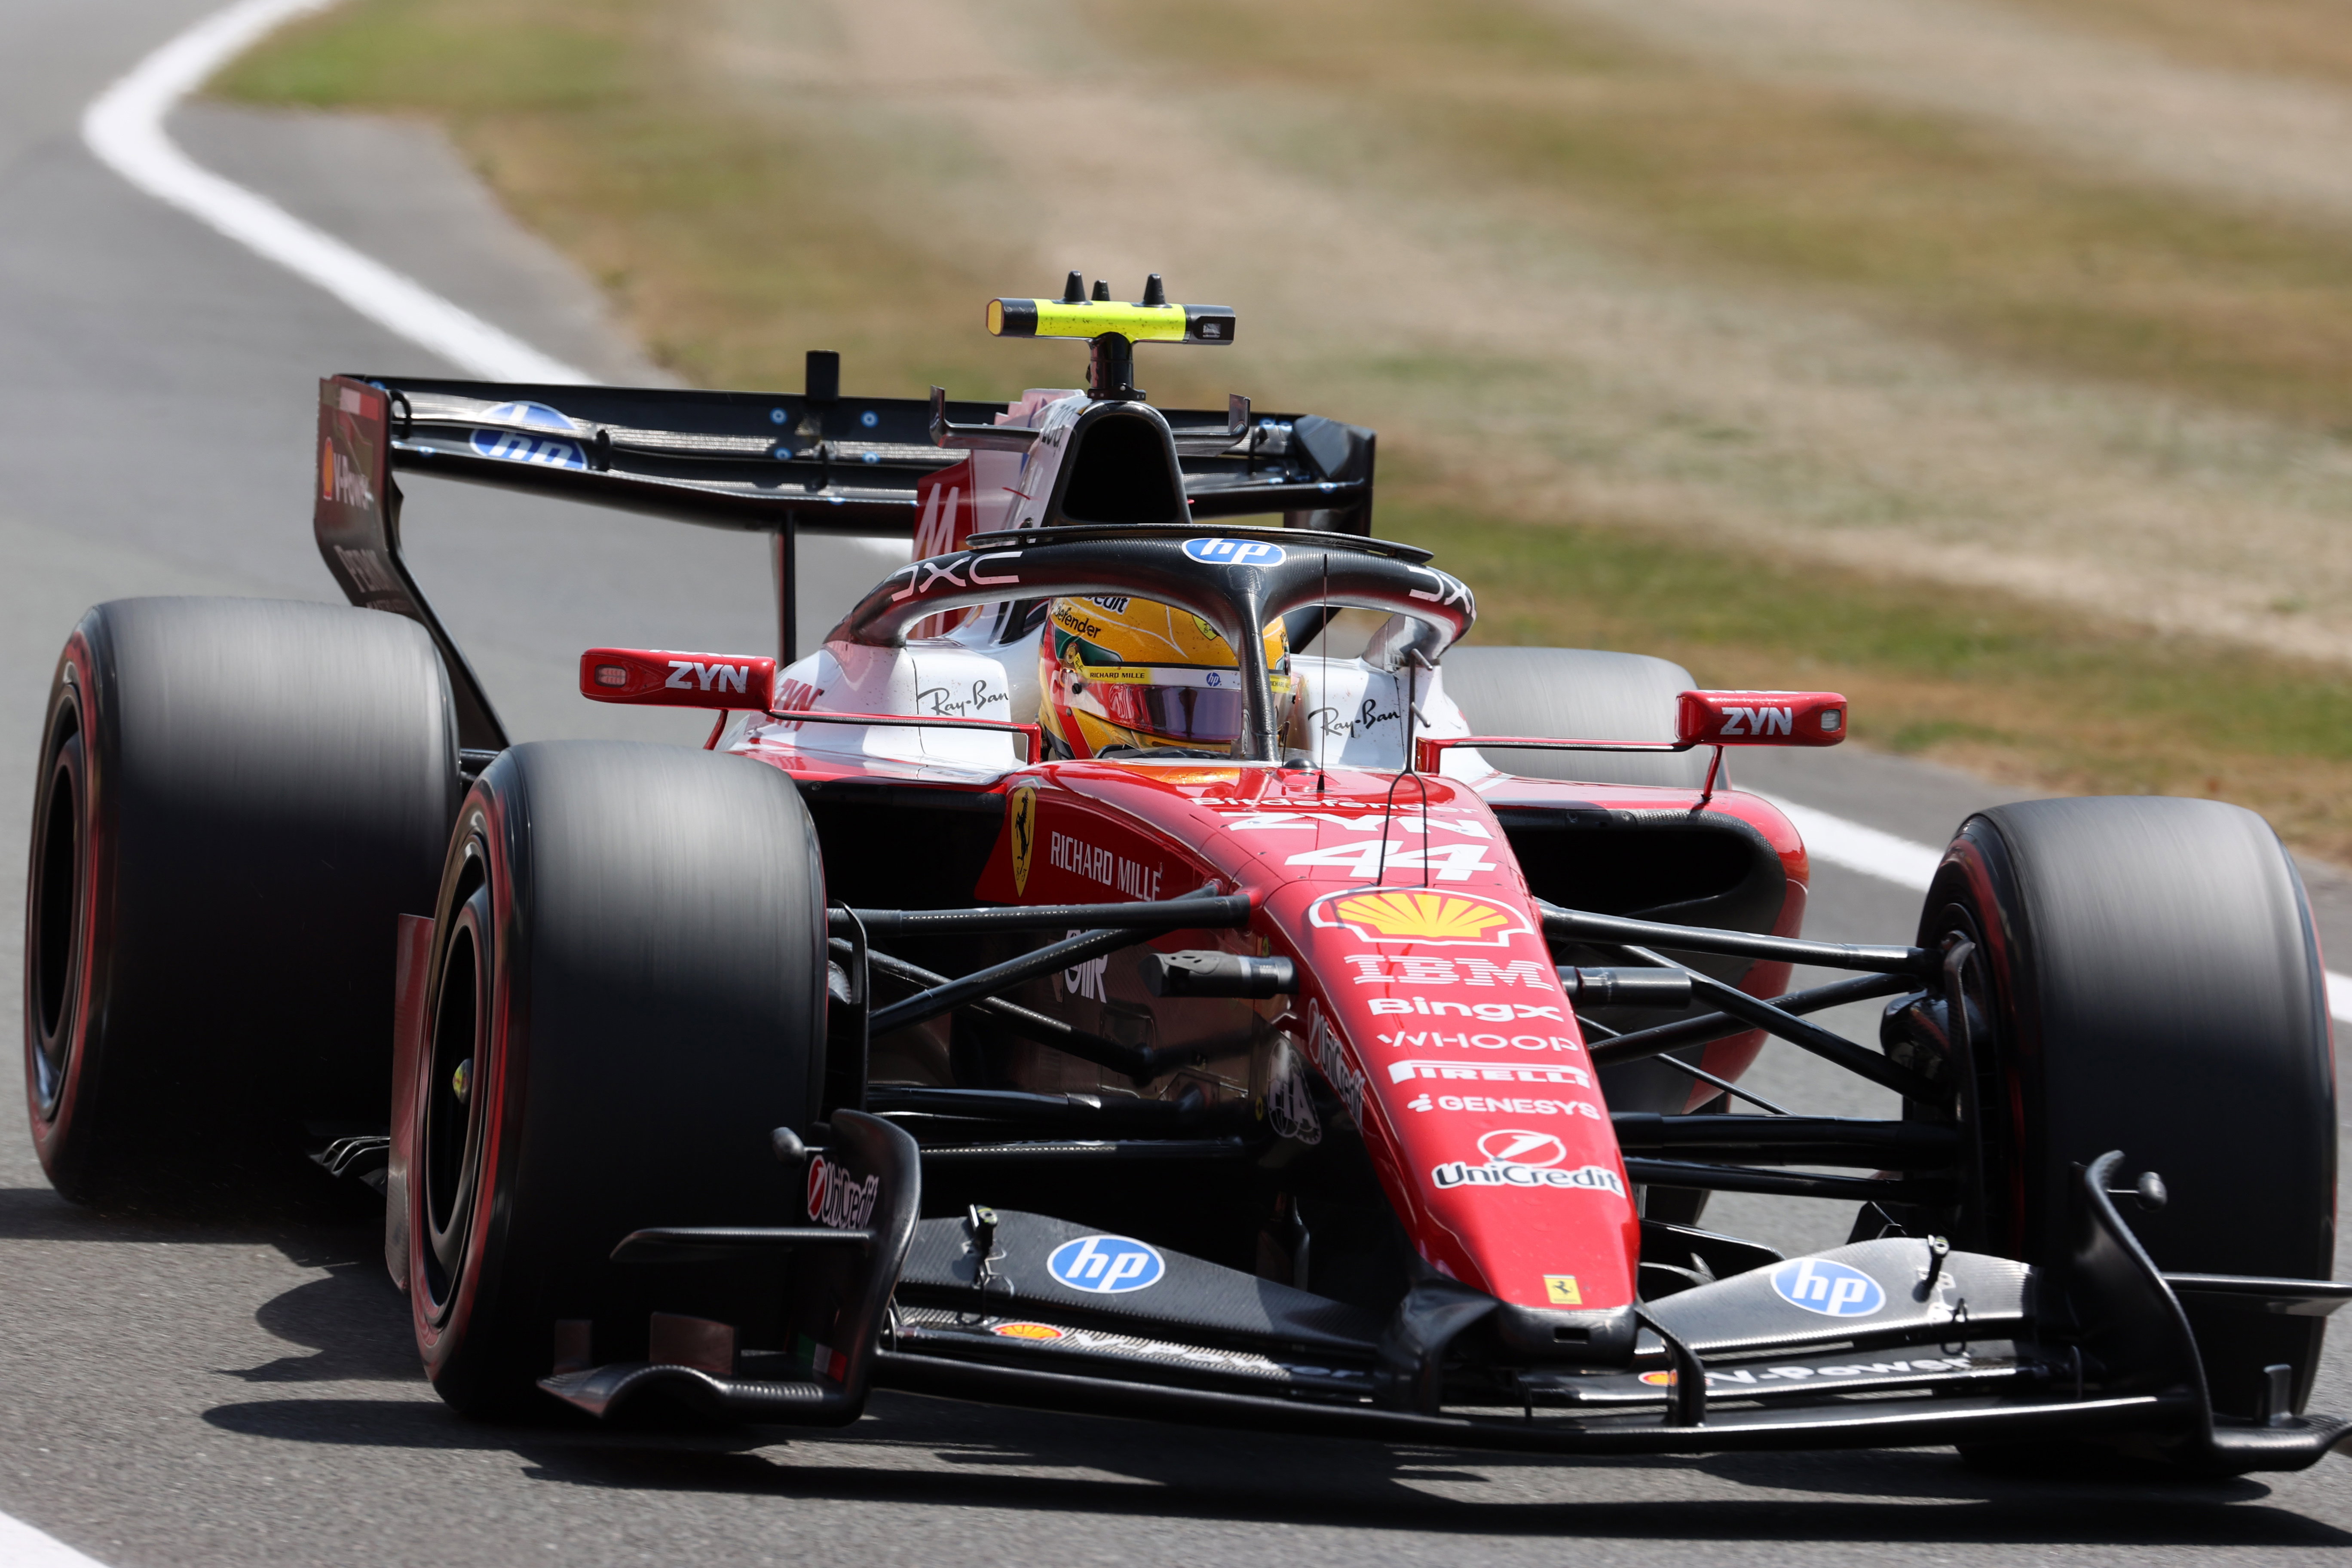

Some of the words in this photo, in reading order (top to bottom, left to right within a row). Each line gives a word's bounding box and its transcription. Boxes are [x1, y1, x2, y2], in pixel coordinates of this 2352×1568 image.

[1199, 539, 1271, 564] hp
[891, 551, 1023, 602] DXC
[665, 661, 749, 693] ZYN
[1208, 672, 1219, 686] hp
[918, 680, 1008, 716] Ray-Ban
[1308, 699, 1400, 738] Ray-Ban
[1720, 707, 1792, 735] ZYN
[1189, 797, 1478, 815] Bitdefender
[1219, 812, 1494, 840] ZYN
[1050, 831, 1113, 885] RICHARD
[1285, 840, 1496, 881] 44
[1344, 955, 1554, 991] IBM
[1377, 1031, 1579, 1051] WHOOP
[1387, 1059, 1591, 1089] PIRELLI
[1438, 1096, 1600, 1120] GENESYS
[821, 1161, 880, 1229] UniCredit
[1432, 1163, 1625, 1197] UniCredit
[1066, 1238, 1149, 1289] hp
[1792, 1260, 1867, 1316] hp
[1705, 1352, 1972, 1384] V-Power
